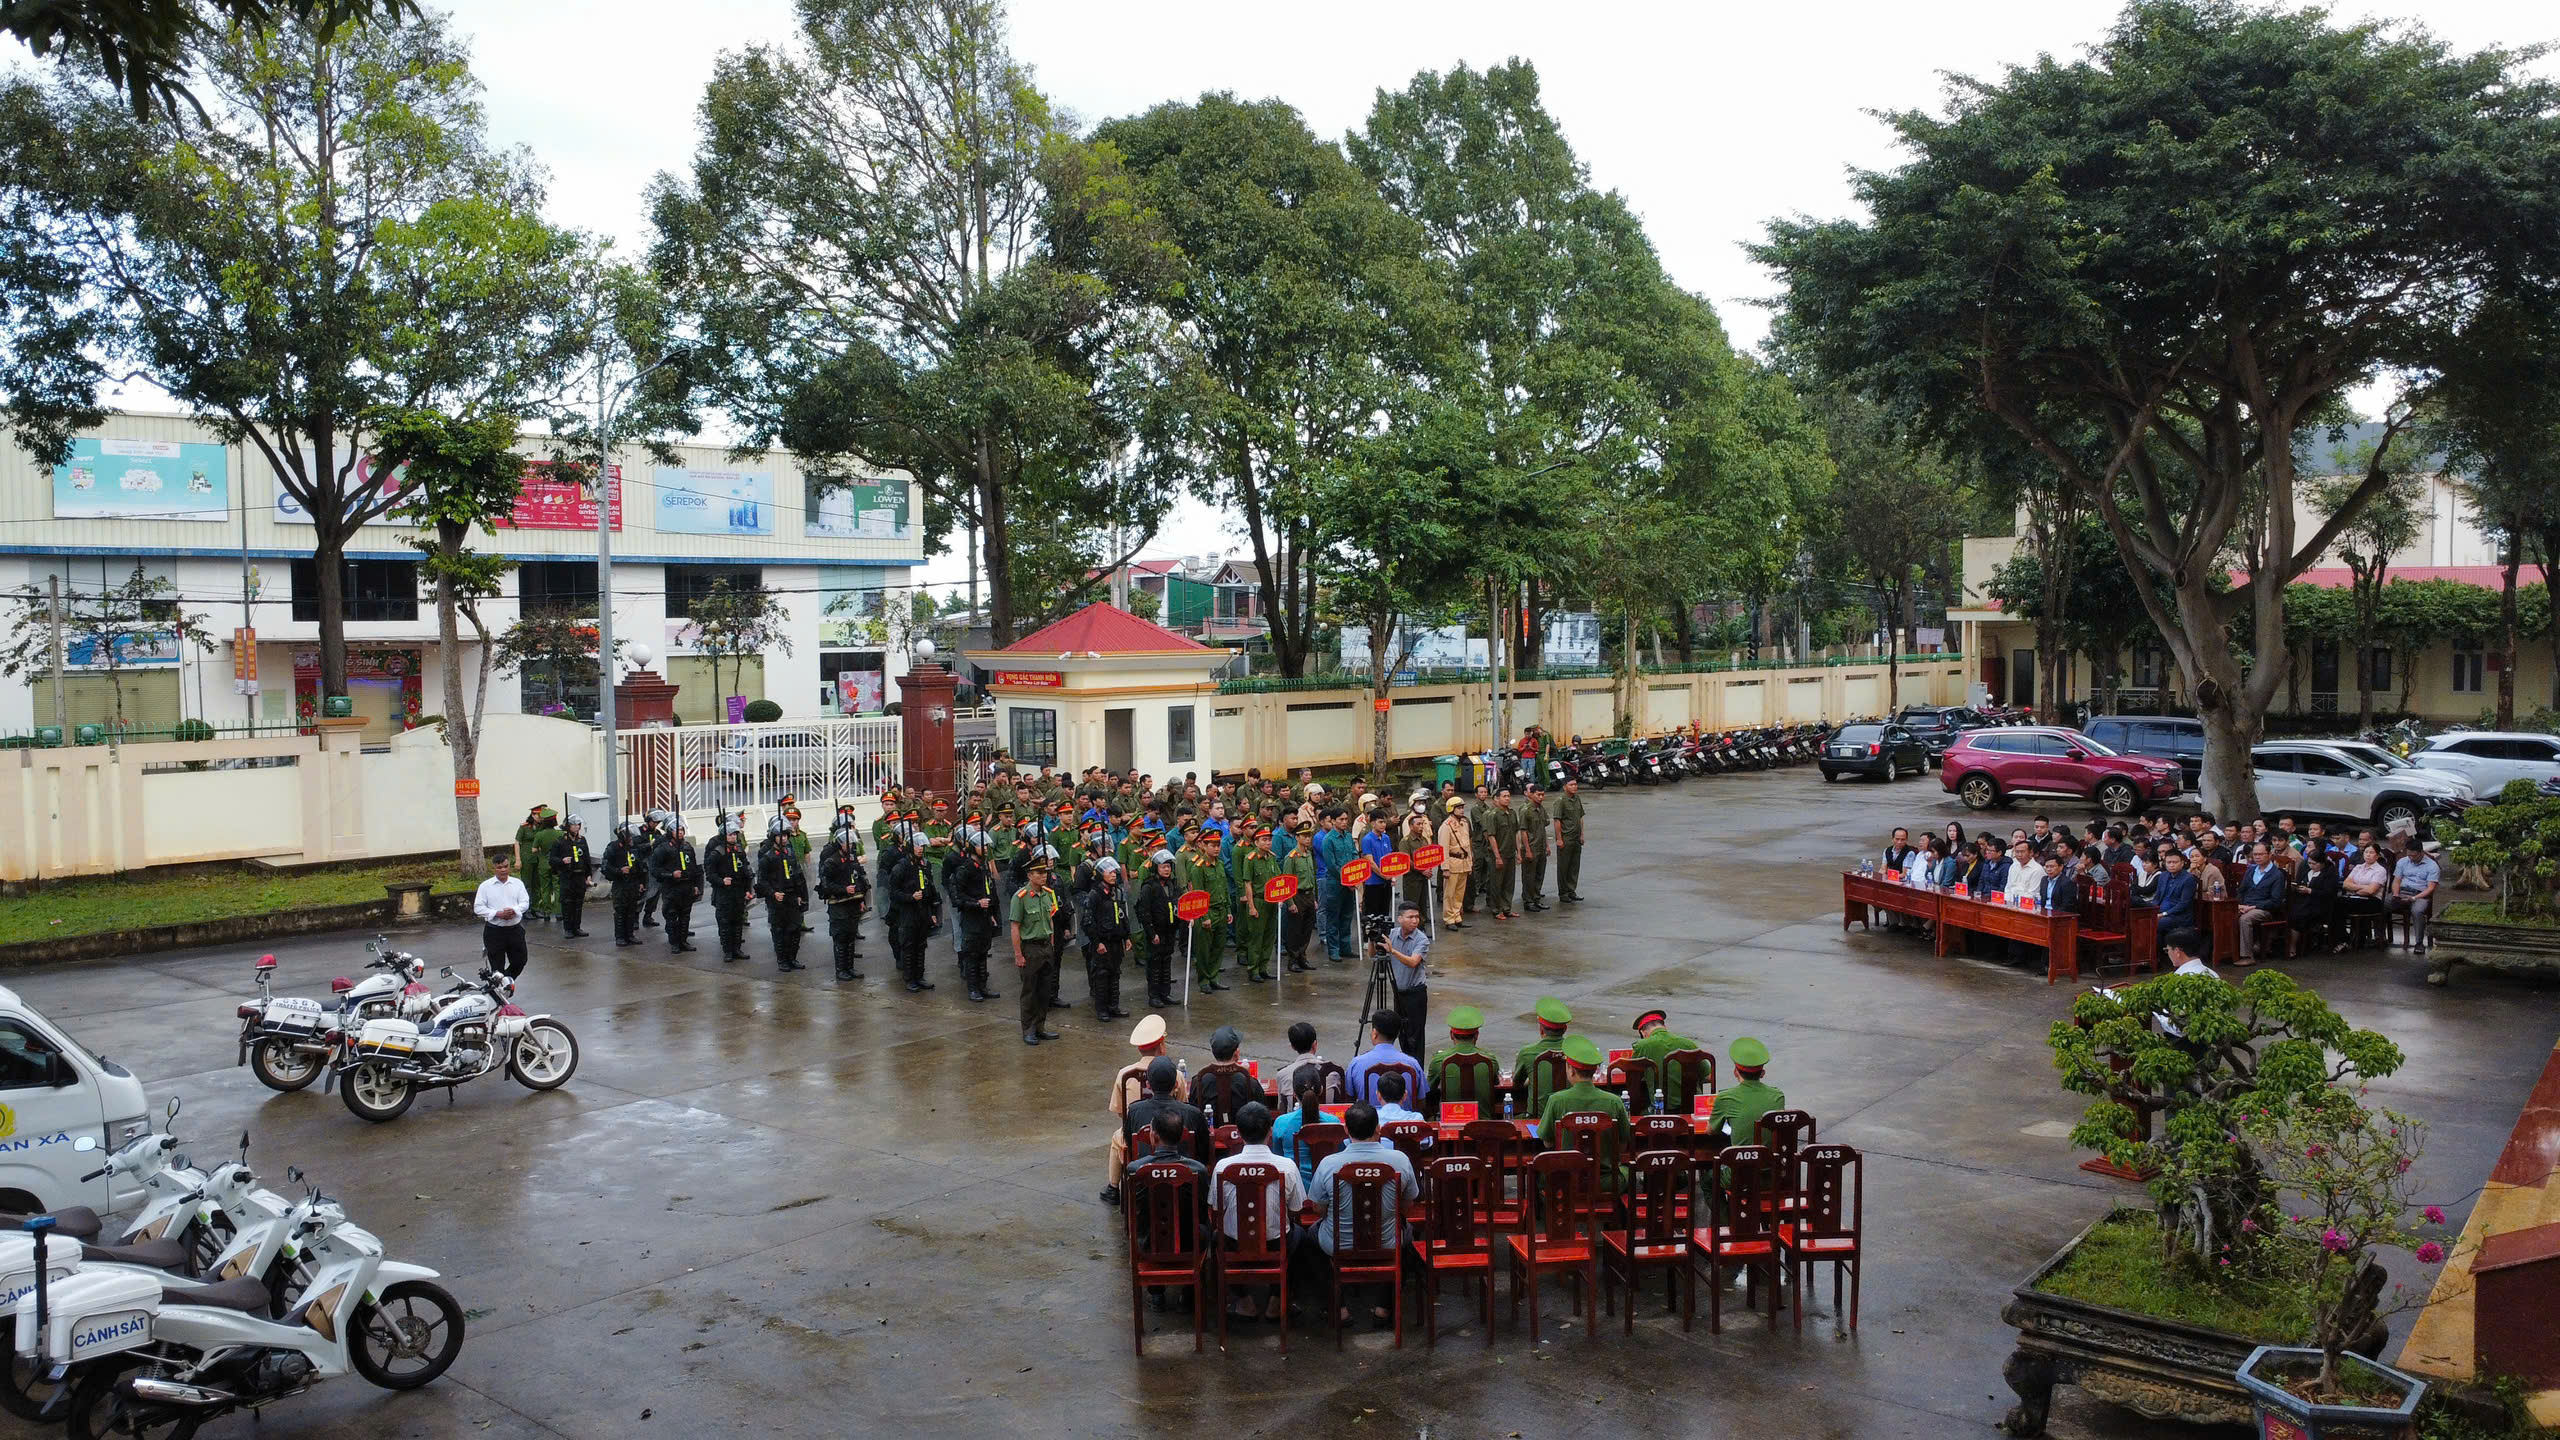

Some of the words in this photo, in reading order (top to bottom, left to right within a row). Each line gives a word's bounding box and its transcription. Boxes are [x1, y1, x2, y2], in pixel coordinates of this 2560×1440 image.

[665, 496, 707, 507] SEREPOK
[452, 1004, 475, 1015] CSGT
[1575, 1115, 1599, 1125] B30
[1774, 1113, 1798, 1123] C37
[1650, 1120, 1675, 1129] C30
[1394, 1125, 1418, 1135] A10
[38, 1129, 70, 1147] XÃ
[1735, 1151, 1759, 1160] A03
[1815, 1150, 1841, 1159] A33
[1650, 1156, 1676, 1166] A17
[1238, 1167, 1266, 1177] A02
[1445, 1162, 1471, 1173] B04
[1151, 1169, 1178, 1179] C12
[1355, 1168, 1381, 1178] C23
[74, 1325, 119, 1348] CẢNH
[120, 1315, 145, 1335] SÁT
